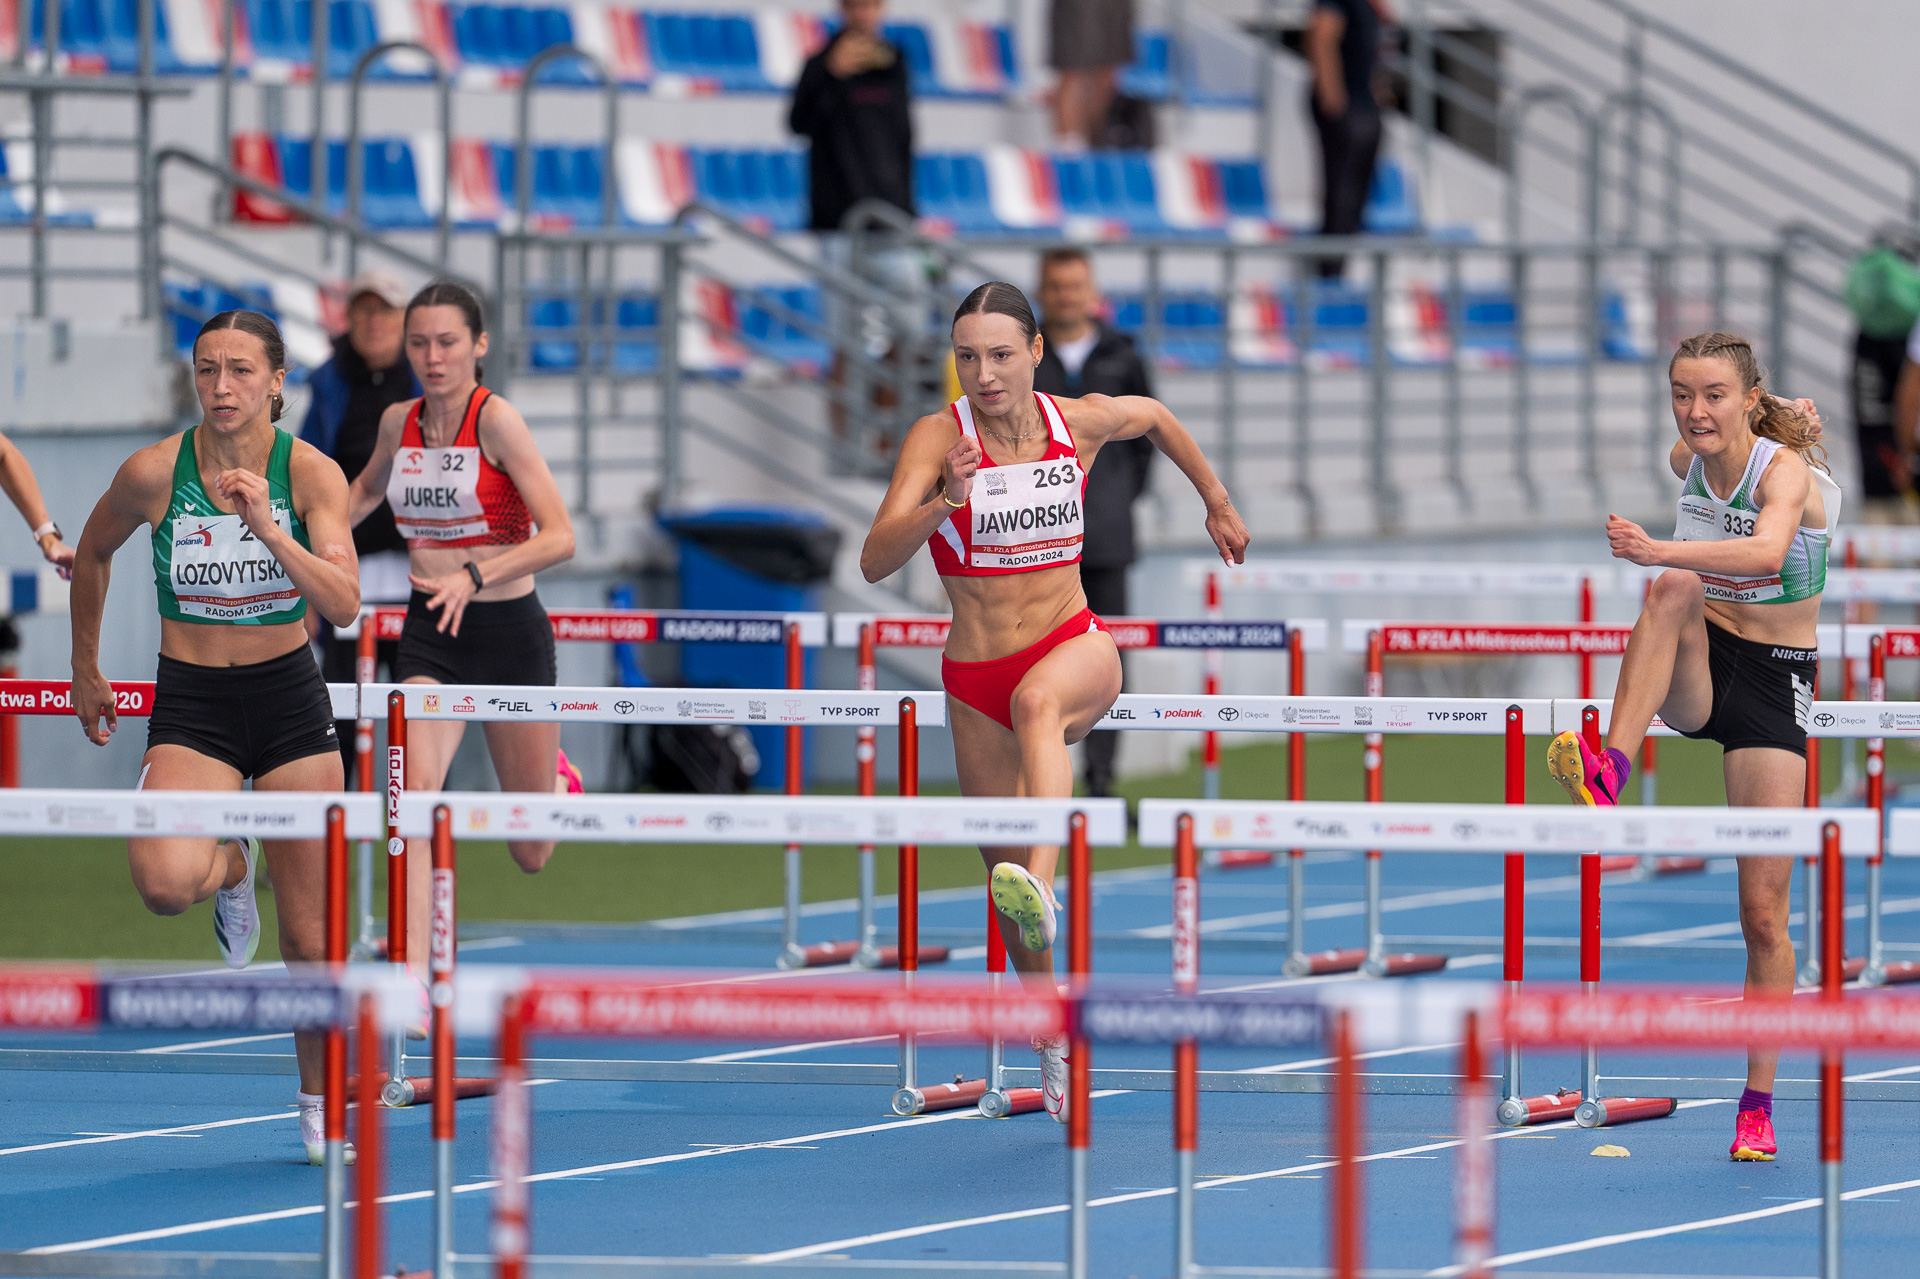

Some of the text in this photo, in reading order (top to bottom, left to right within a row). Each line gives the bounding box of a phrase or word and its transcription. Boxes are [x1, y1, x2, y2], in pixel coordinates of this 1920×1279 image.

[442, 454, 464, 471] 32
[1033, 464, 1076, 489] 263
[403, 487, 460, 508] JUREK
[976, 500, 1080, 535] JAWORSKA
[1723, 513, 1756, 537] 333
[175, 537, 204, 548] polanik
[1011, 543, 1047, 553] Mistrzostwa
[1048, 540, 1067, 548] Polski
[1067, 537, 1078, 545] U20
[999, 550, 1064, 566] RADOM 2024
[215, 597, 254, 606] Mistrzostwa
[255, 594, 276, 602] Polski
[1733, 591, 1757, 600] 2024
[205, 602, 273, 617] RADOM 2024
[663, 619, 732, 641] RADOM
[1771, 647, 1806, 661] NIKE
[499, 701, 534, 712] FUEL
[560, 701, 599, 712] polanik
[640, 704, 665, 713] Okęcie
[820, 707, 881, 717] TVP SPORT
[1164, 708, 1203, 720] polanik
[1244, 711, 1270, 720] Okęcie
[1427, 712, 1488, 721] TVP SPORT
[1841, 717, 1866, 725] Okęcie
[388, 748, 402, 820] POLANIK
